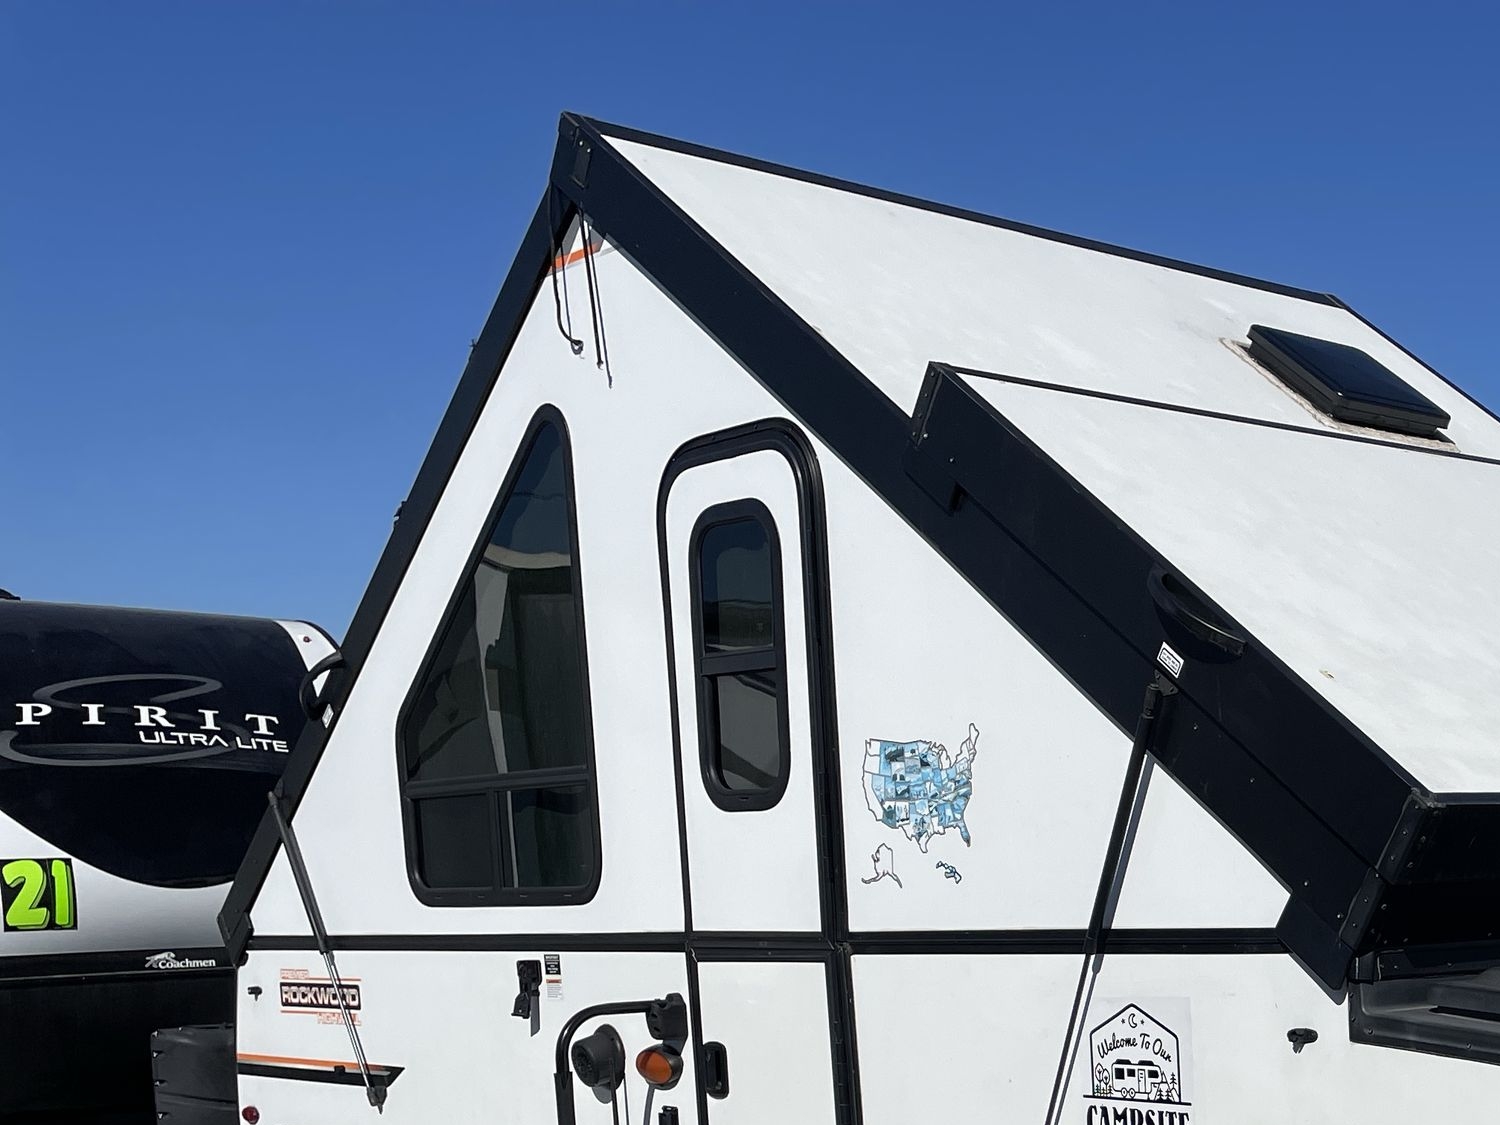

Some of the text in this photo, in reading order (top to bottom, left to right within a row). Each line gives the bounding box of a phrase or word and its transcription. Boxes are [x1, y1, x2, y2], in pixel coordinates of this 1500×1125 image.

[139, 731, 289, 753] ULTRA LITE
[2, 859, 74, 930] 21
[158, 957, 216, 970] Coachmen
[1097, 1032, 1172, 1063] Welcome To Our
